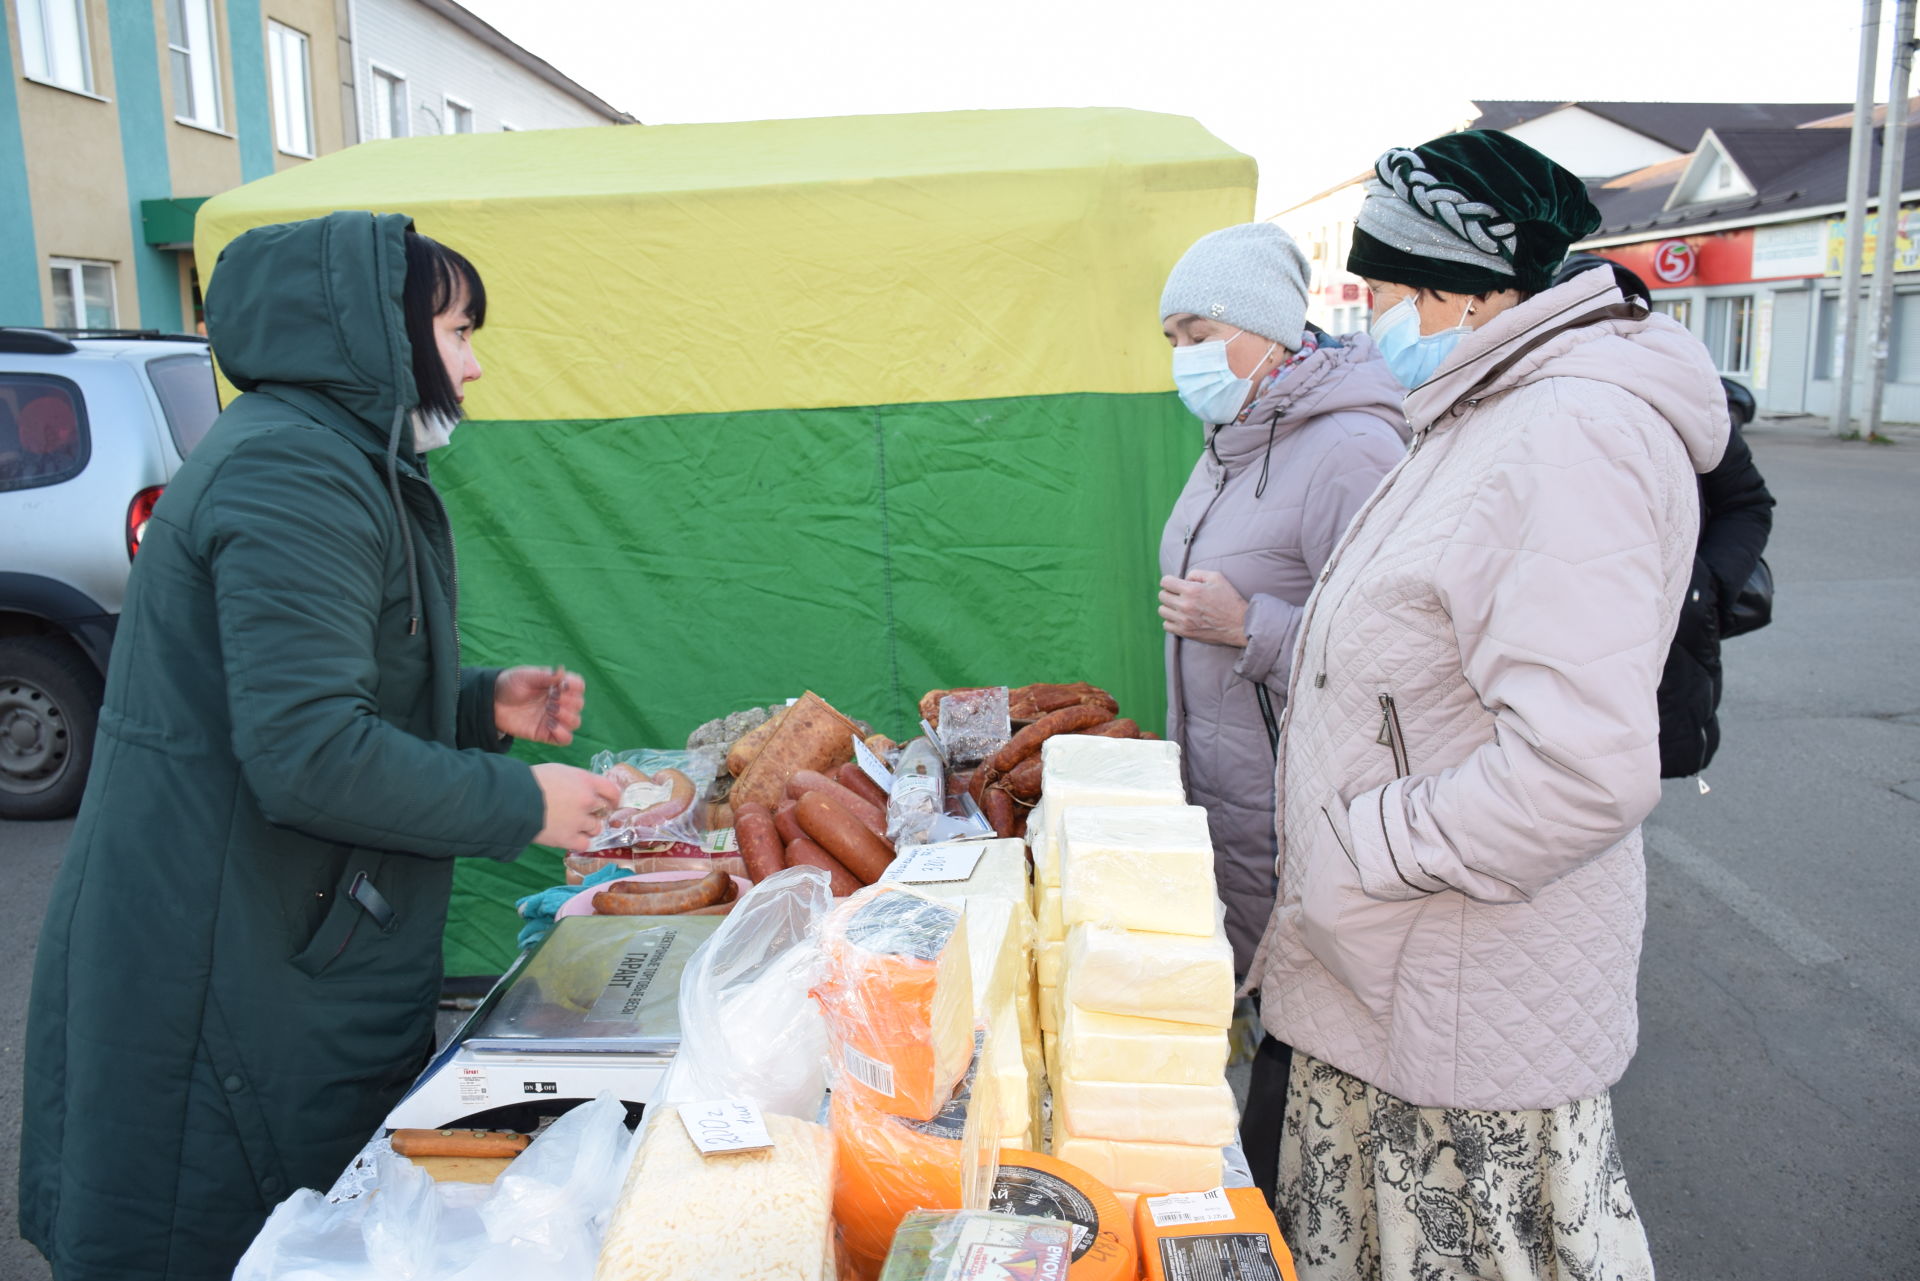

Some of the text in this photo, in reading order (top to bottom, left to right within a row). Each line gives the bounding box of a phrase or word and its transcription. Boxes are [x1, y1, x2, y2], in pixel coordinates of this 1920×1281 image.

[1661, 247, 1687, 279] 5
[608, 952, 648, 988] ГАРАНТ
[631, 968, 658, 997] ТОРГОВЫЕ
[620, 996, 642, 1015] ВЕСЫ
